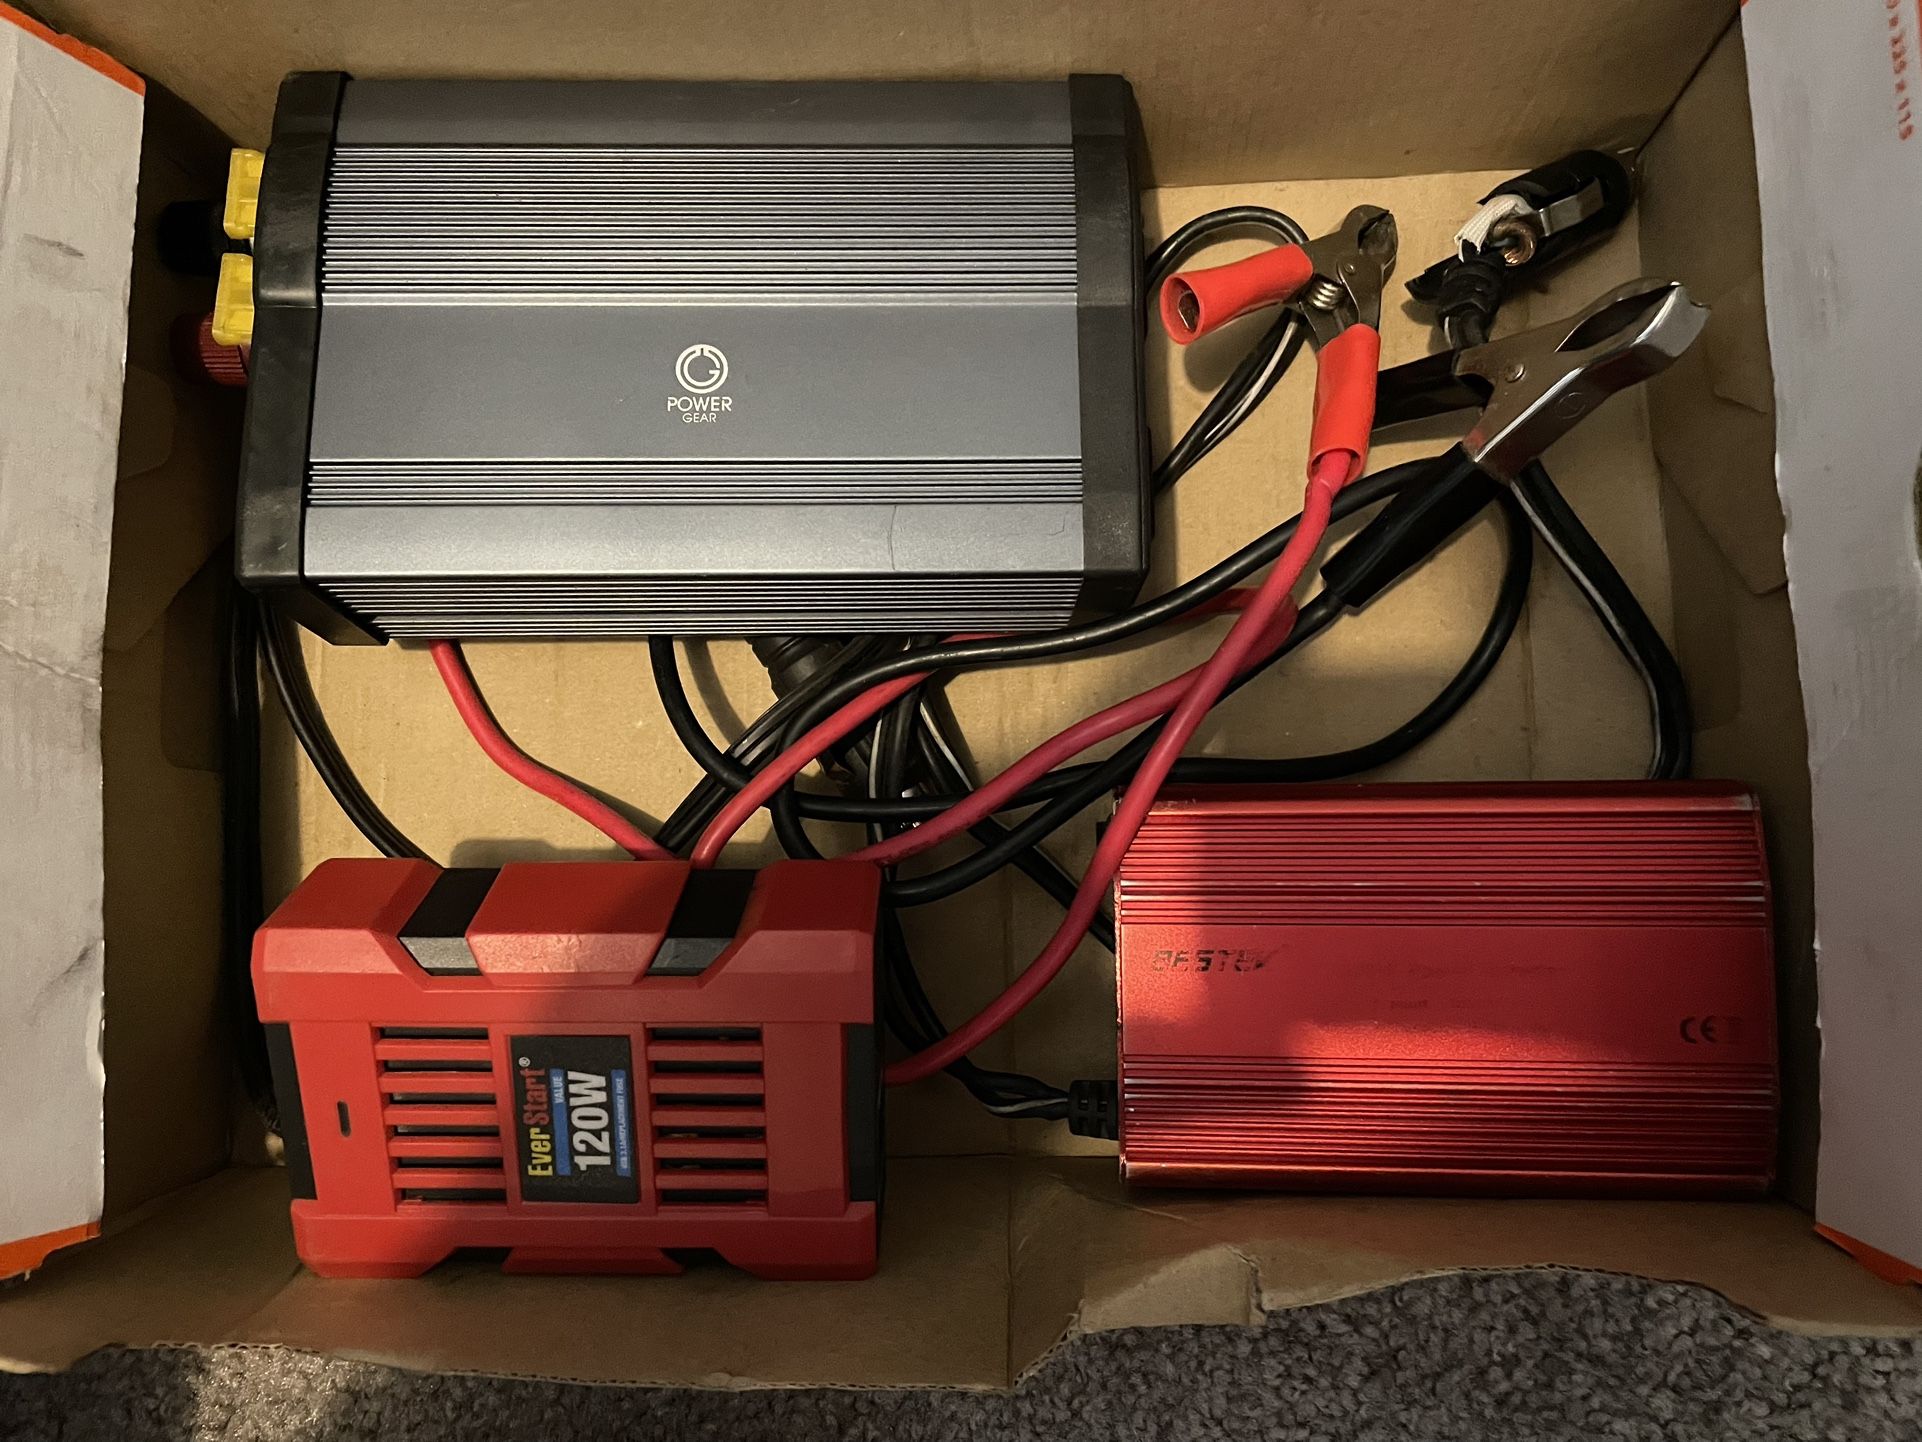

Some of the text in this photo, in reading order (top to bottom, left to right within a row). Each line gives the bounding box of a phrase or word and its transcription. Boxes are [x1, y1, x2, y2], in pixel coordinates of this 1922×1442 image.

[667, 396, 733, 412] POWER
[682, 412, 717, 423] GEAR
[552, 1075, 565, 1104] VALUE
[567, 1070, 612, 1171] 120W
